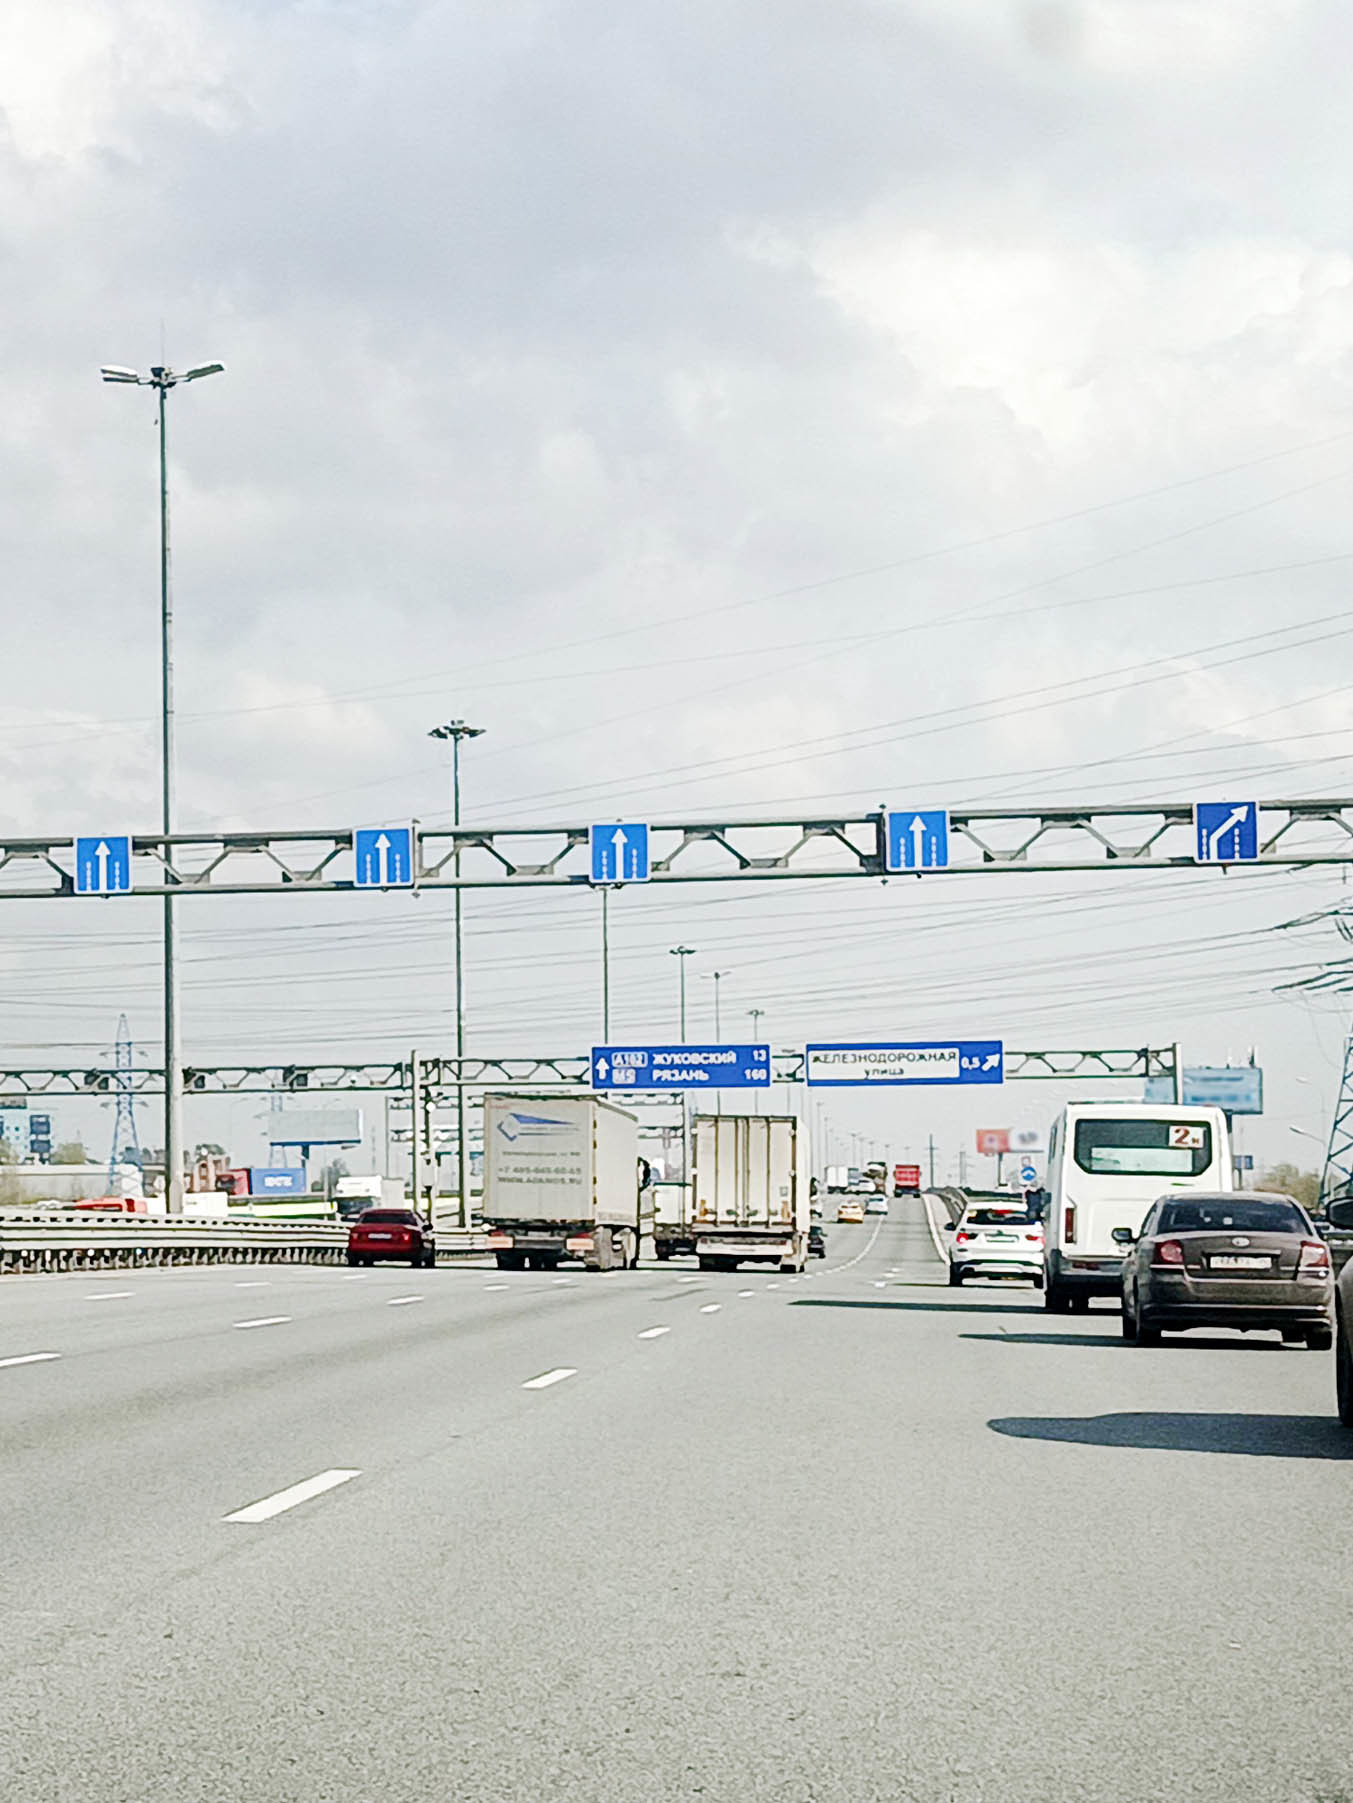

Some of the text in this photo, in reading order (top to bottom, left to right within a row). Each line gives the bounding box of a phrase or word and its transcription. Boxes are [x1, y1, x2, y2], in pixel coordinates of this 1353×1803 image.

[652, 1050, 737, 1065] ЖУКОВСКИЙ
[753, 1049, 767, 1062] 13
[812, 1051, 957, 1065] ЖЕЛЕЗНОДОРОЖНАЯ
[960, 1056, 981, 1071] 0,5
[652, 1069, 710, 1082] РЯЗАНЬ
[863, 1067, 905, 1080] улица
[1174, 1128, 1190, 1145] 2
